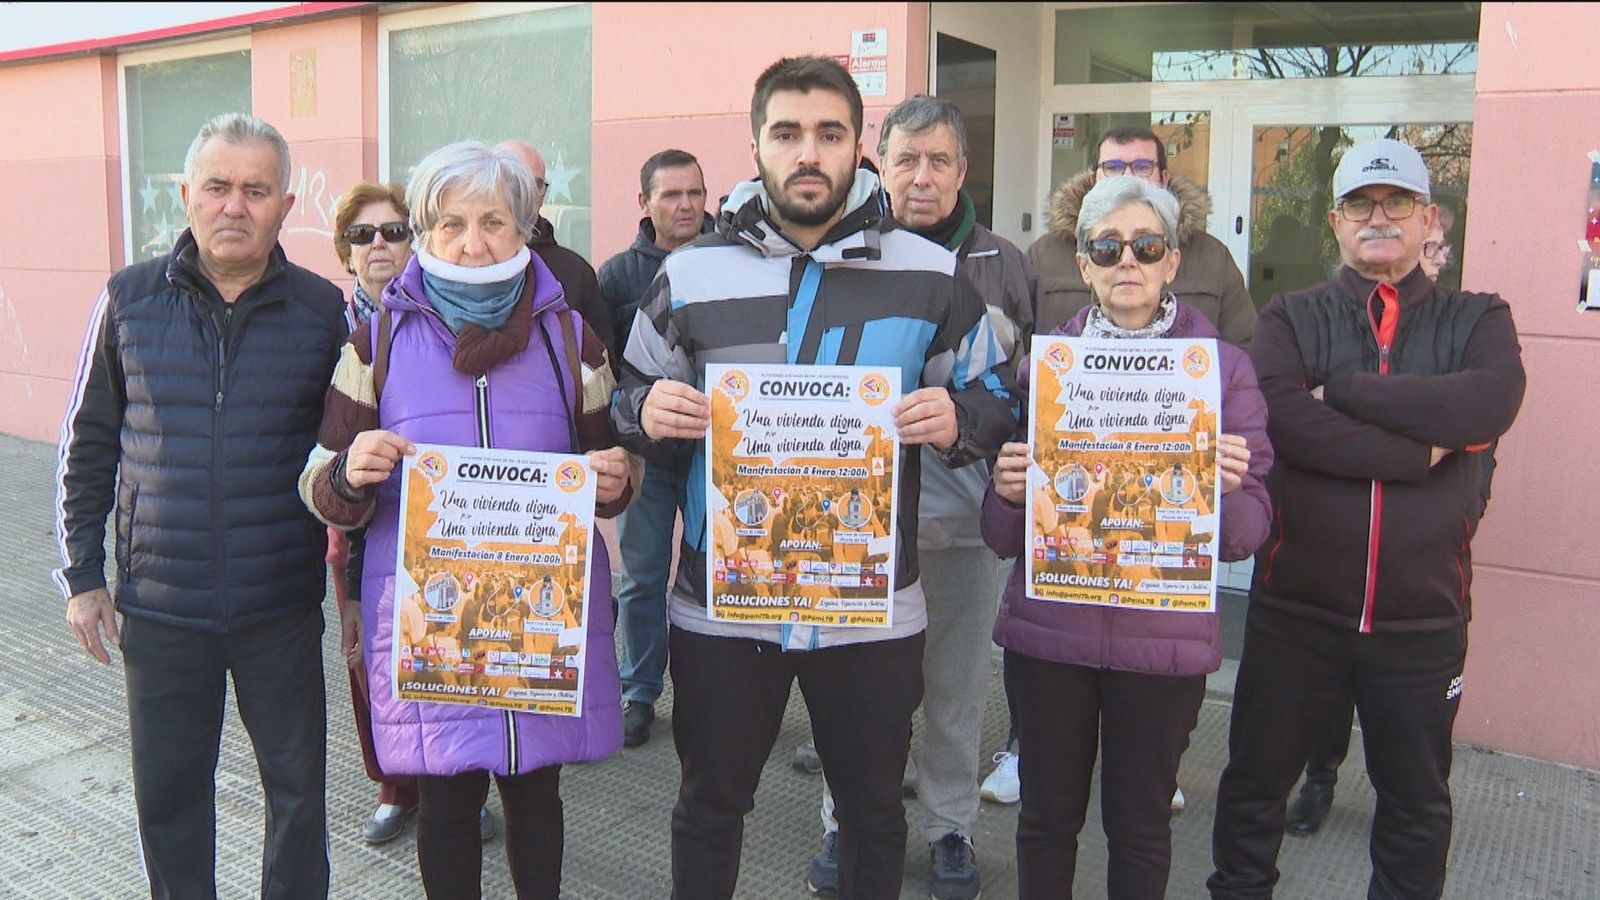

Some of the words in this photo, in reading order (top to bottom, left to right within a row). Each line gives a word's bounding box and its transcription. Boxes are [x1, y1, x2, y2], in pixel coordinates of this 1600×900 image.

[1084, 354, 1174, 372] CONVOCA:
[760, 380, 850, 398] CONVOCA:
[1066, 382, 1095, 402] Una
[1100, 387, 1150, 402] vivienda
[1154, 388, 1187, 408] digna
[743, 408, 772, 428] Una
[777, 412, 826, 428] vivienda
[830, 412, 863, 434] digna
[1066, 410, 1094, 430] Una
[1100, 412, 1149, 427] vivienda
[743, 436, 772, 456] Una
[777, 438, 825, 452] vivienda
[1060, 439, 1124, 450] Manifestación
[1126, 442, 1132, 450] 8
[1134, 442, 1159, 450] Enero
[1162, 443, 1191, 451] 12:00h
[458, 464, 548, 482] CONVOCA:
[738, 464, 800, 476] Manifestación
[803, 466, 809, 475] 8
[812, 467, 836, 476] Enero
[839, 468, 868, 477] 12:00h
[440, 489, 468, 510] Una
[473, 497, 520, 512] vivienda
[526, 500, 558, 519] digna
[438, 519, 467, 538] Una
[472, 522, 520, 536] vivienda
[1100, 518, 1144, 528] APOYAN:
[780, 540, 822, 550] APOYAN:
[431, 548, 494, 560] Manifestación
[497, 552, 502, 560] 8
[505, 552, 530, 562] Enero
[533, 554, 560, 564] 12:00h
[1035, 572, 1110, 588] ¡SOLUCIONES
[1114, 578, 1132, 589] YA!
[716, 594, 790, 606] ¡SOLUCIONES
[794, 597, 812, 608] YA!
[468, 628, 512, 639] APOYAN:
[402, 682, 478, 694] ¡SOLUCIONES
[481, 686, 500, 696] YA!
